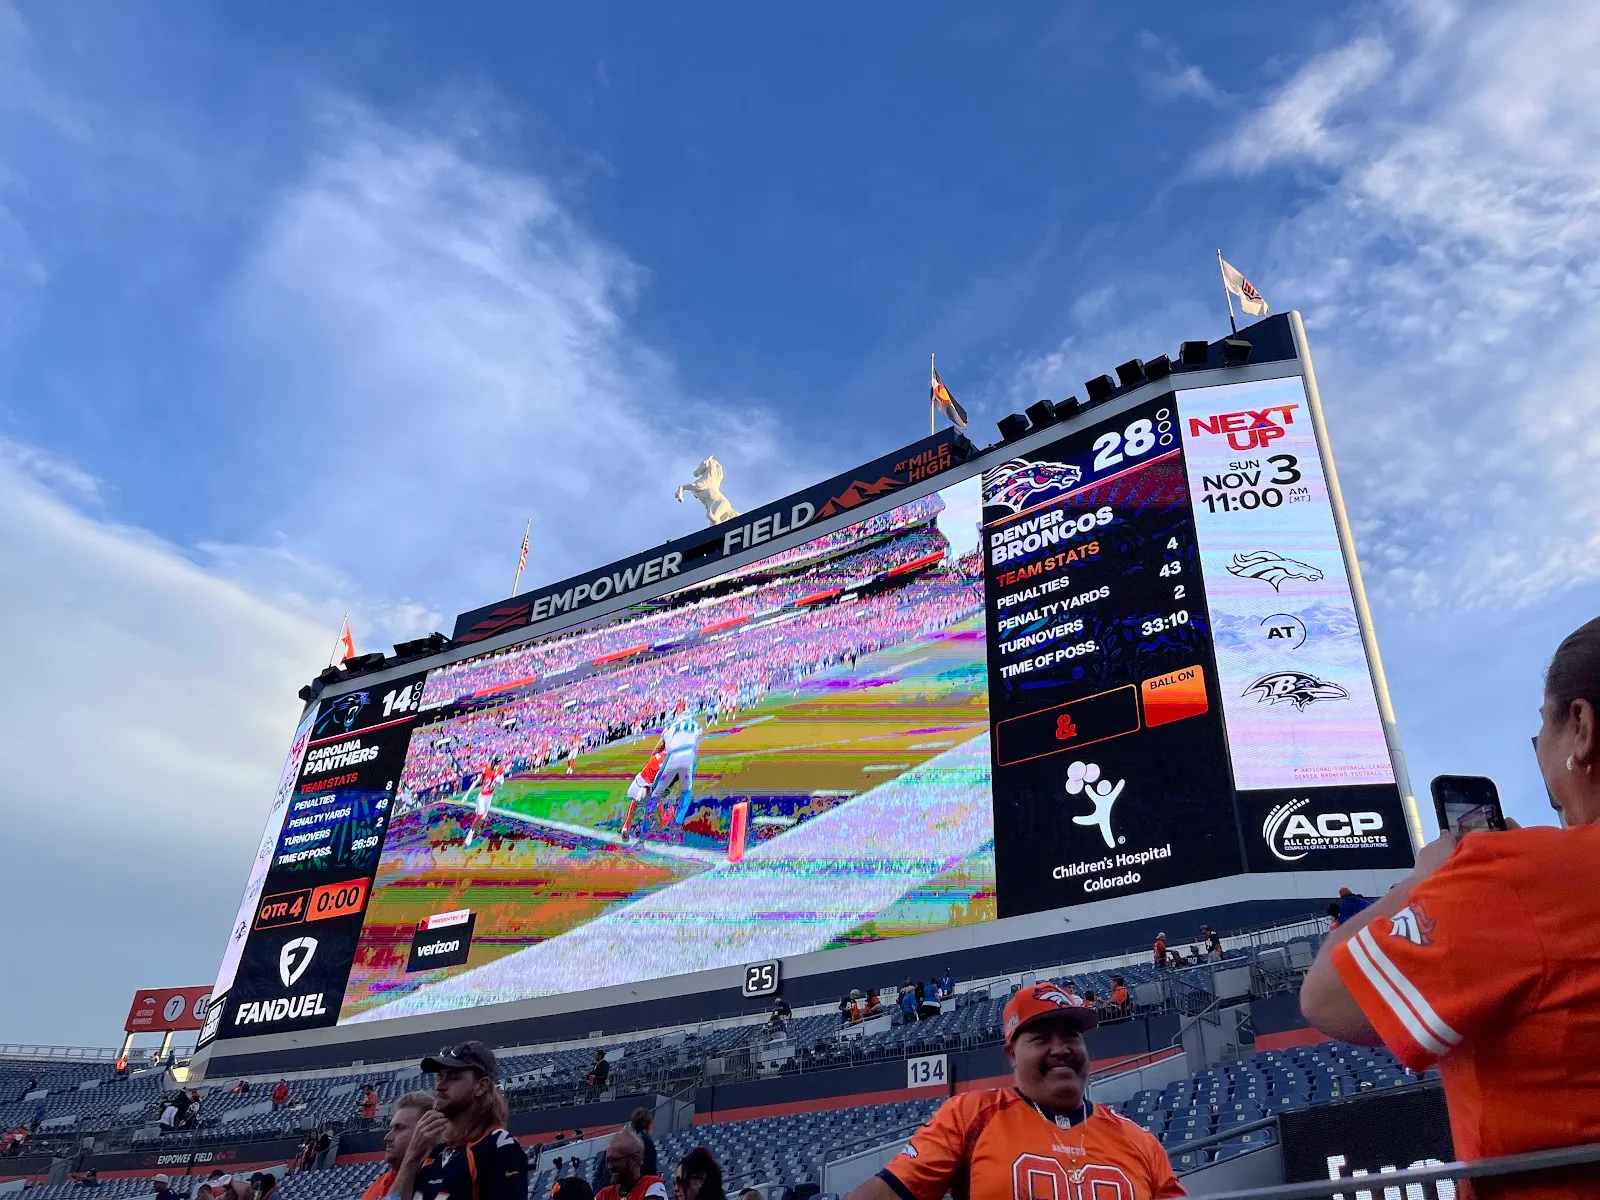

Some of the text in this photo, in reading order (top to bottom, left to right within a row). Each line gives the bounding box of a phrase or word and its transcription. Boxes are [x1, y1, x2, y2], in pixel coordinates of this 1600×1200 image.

[1188, 404, 1299, 438] NEXT
[1093, 418, 1156, 472] 28
[1226, 426, 1285, 451] UP
[894, 461, 907, 472] AT
[908, 443, 949, 469] MILE
[908, 456, 951, 483] HIGH
[1229, 459, 1259, 471] SUN
[1203, 454, 1301, 492] NOV 3
[1202, 487, 1308, 514] 11:00 AM
[991, 509, 1064, 548] DENVER
[991, 505, 1113, 566] BRONCOS
[530, 501, 816, 624] EMPOWER FIELD
[996, 541, 1100, 589] TEAM STATS
[996, 537, 1178, 610] PENALTIES 4
[997, 560, 1182, 633] PENALTY YARDS 43
[998, 585, 1186, 656] TURNOVERS 2
[1266, 626, 1296, 640] AT
[999, 609, 1189, 679] TIME OF POSS. 33:10
[1149, 669, 1196, 691] BALL ON
[382, 687, 412, 718] 14
[1055, 714, 1078, 740] &
[303, 744, 380, 777] PANTHERS
[307, 738, 362, 762] CAROLINA
[294, 780, 393, 811] PENALTIES 8
[300, 772, 358, 795] TEAM STATS
[289, 798, 389, 829] PENALTY YARDS 49
[1283, 812, 1383, 838] ACP
[284, 816, 384, 848] TURNOVERS 2
[1284, 835, 1387, 846] ALL COPY PRODUCTS
[278, 852, 299, 866] TIME
[351, 836, 379, 851] 26:50
[1116, 845, 1172, 871] Hospital
[1083, 871, 1141, 893] Colorado
[260, 896, 303, 920] QTR 4
[317, 886, 360, 912] 0:00
[417, 939, 460, 957] verizon
[748, 966, 773, 991] 25
[170, 1000, 180, 1017] 7
[234, 993, 327, 1026] FANDUEL
[910, 1058, 945, 1084] 134
